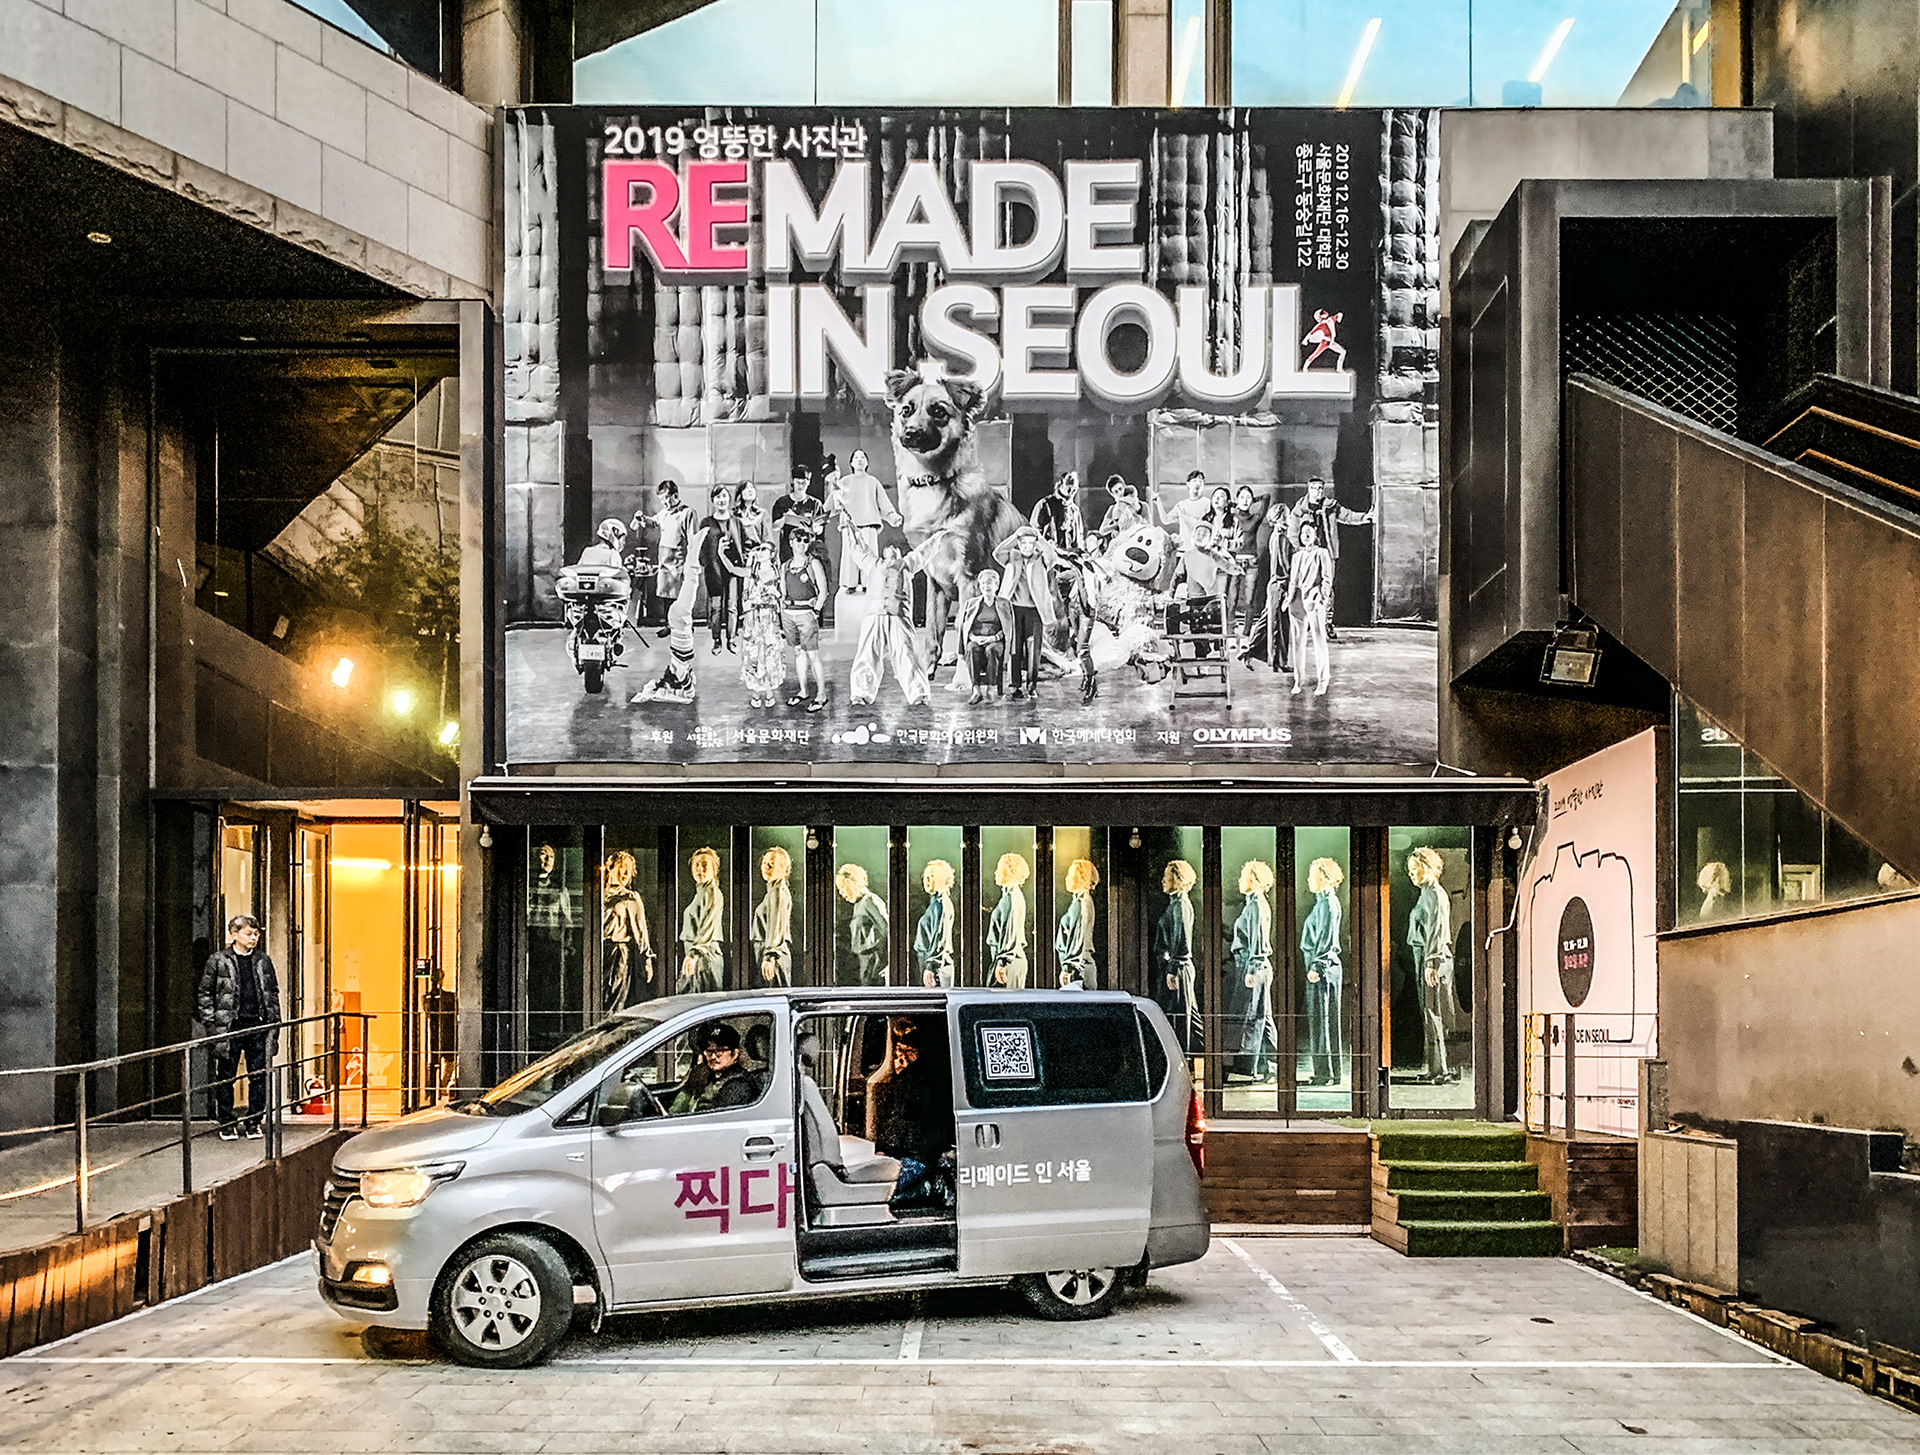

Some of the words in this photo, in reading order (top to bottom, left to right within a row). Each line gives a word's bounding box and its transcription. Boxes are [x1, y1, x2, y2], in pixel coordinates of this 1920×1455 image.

[604, 126, 685, 155] 2019
[693, 126, 777, 158] 엉뚱한
[783, 126, 868, 158] 사진관
[1295, 142, 1314, 189] 종로구
[1335, 143, 1350, 181] 2019
[1315, 142, 1332, 225] 서울문화재단
[602, 158, 1145, 284] REMADE
[1315, 228, 1332, 270] 대학로
[767, 284, 895, 401] IN
[921, 283, 1357, 402] SEOUL
[650, 730, 674, 744] 후원
[732, 728, 811, 746] 서울문화재단
[1156, 730, 1181, 745] 지원
[1192, 727, 1293, 743] OLYMPUS
[959, 1163, 1031, 1188] 리메이드
[1035, 1161, 1052, 1184] 인
[1057, 1159, 1092, 1182] 서울
[674, 1162, 795, 1234] 찍다
